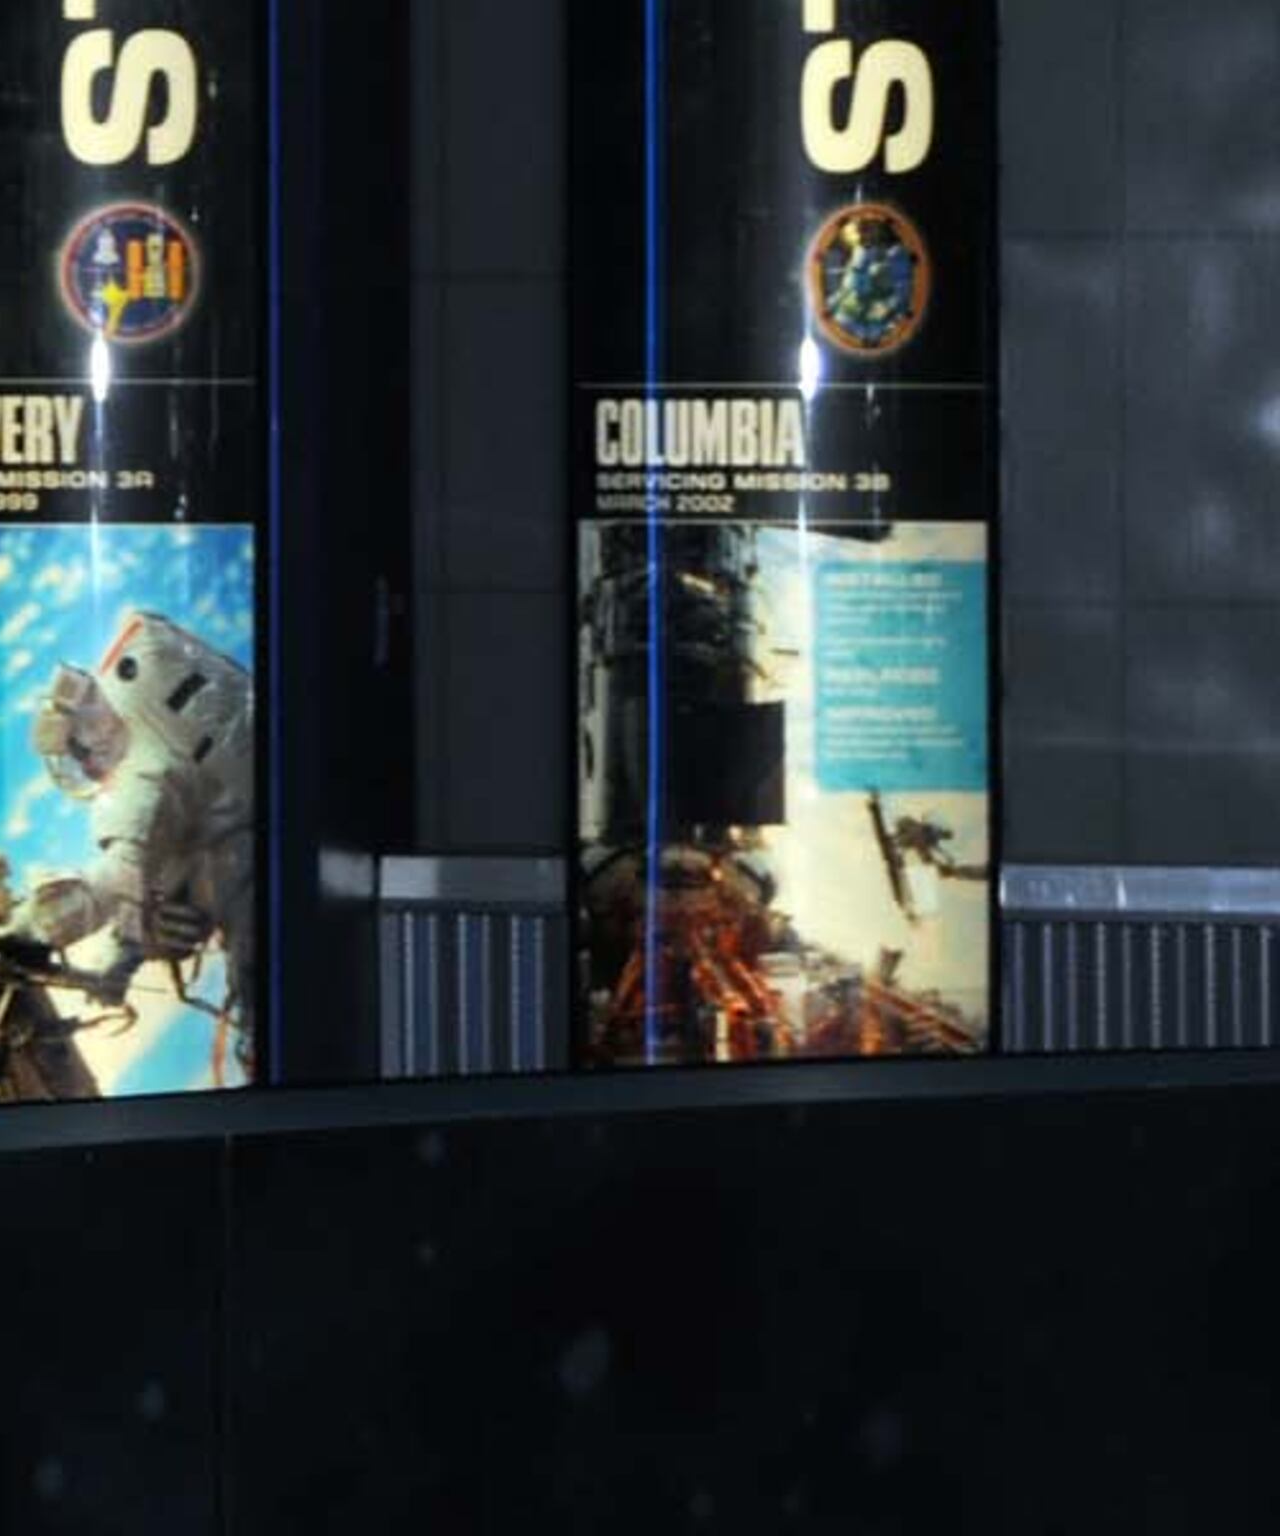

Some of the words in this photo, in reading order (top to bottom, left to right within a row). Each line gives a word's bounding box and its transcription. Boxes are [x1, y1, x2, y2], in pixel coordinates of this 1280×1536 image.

[596, 399, 807, 466] COLUMBIA
[116, 472, 155, 490] 3A
[596, 473, 726, 491] SERVICING
[733, 473, 847, 491] MISSION
[854, 474, 890, 491] 3B
[596, 495, 670, 511] MARCH
[676, 495, 736, 513] 2002
